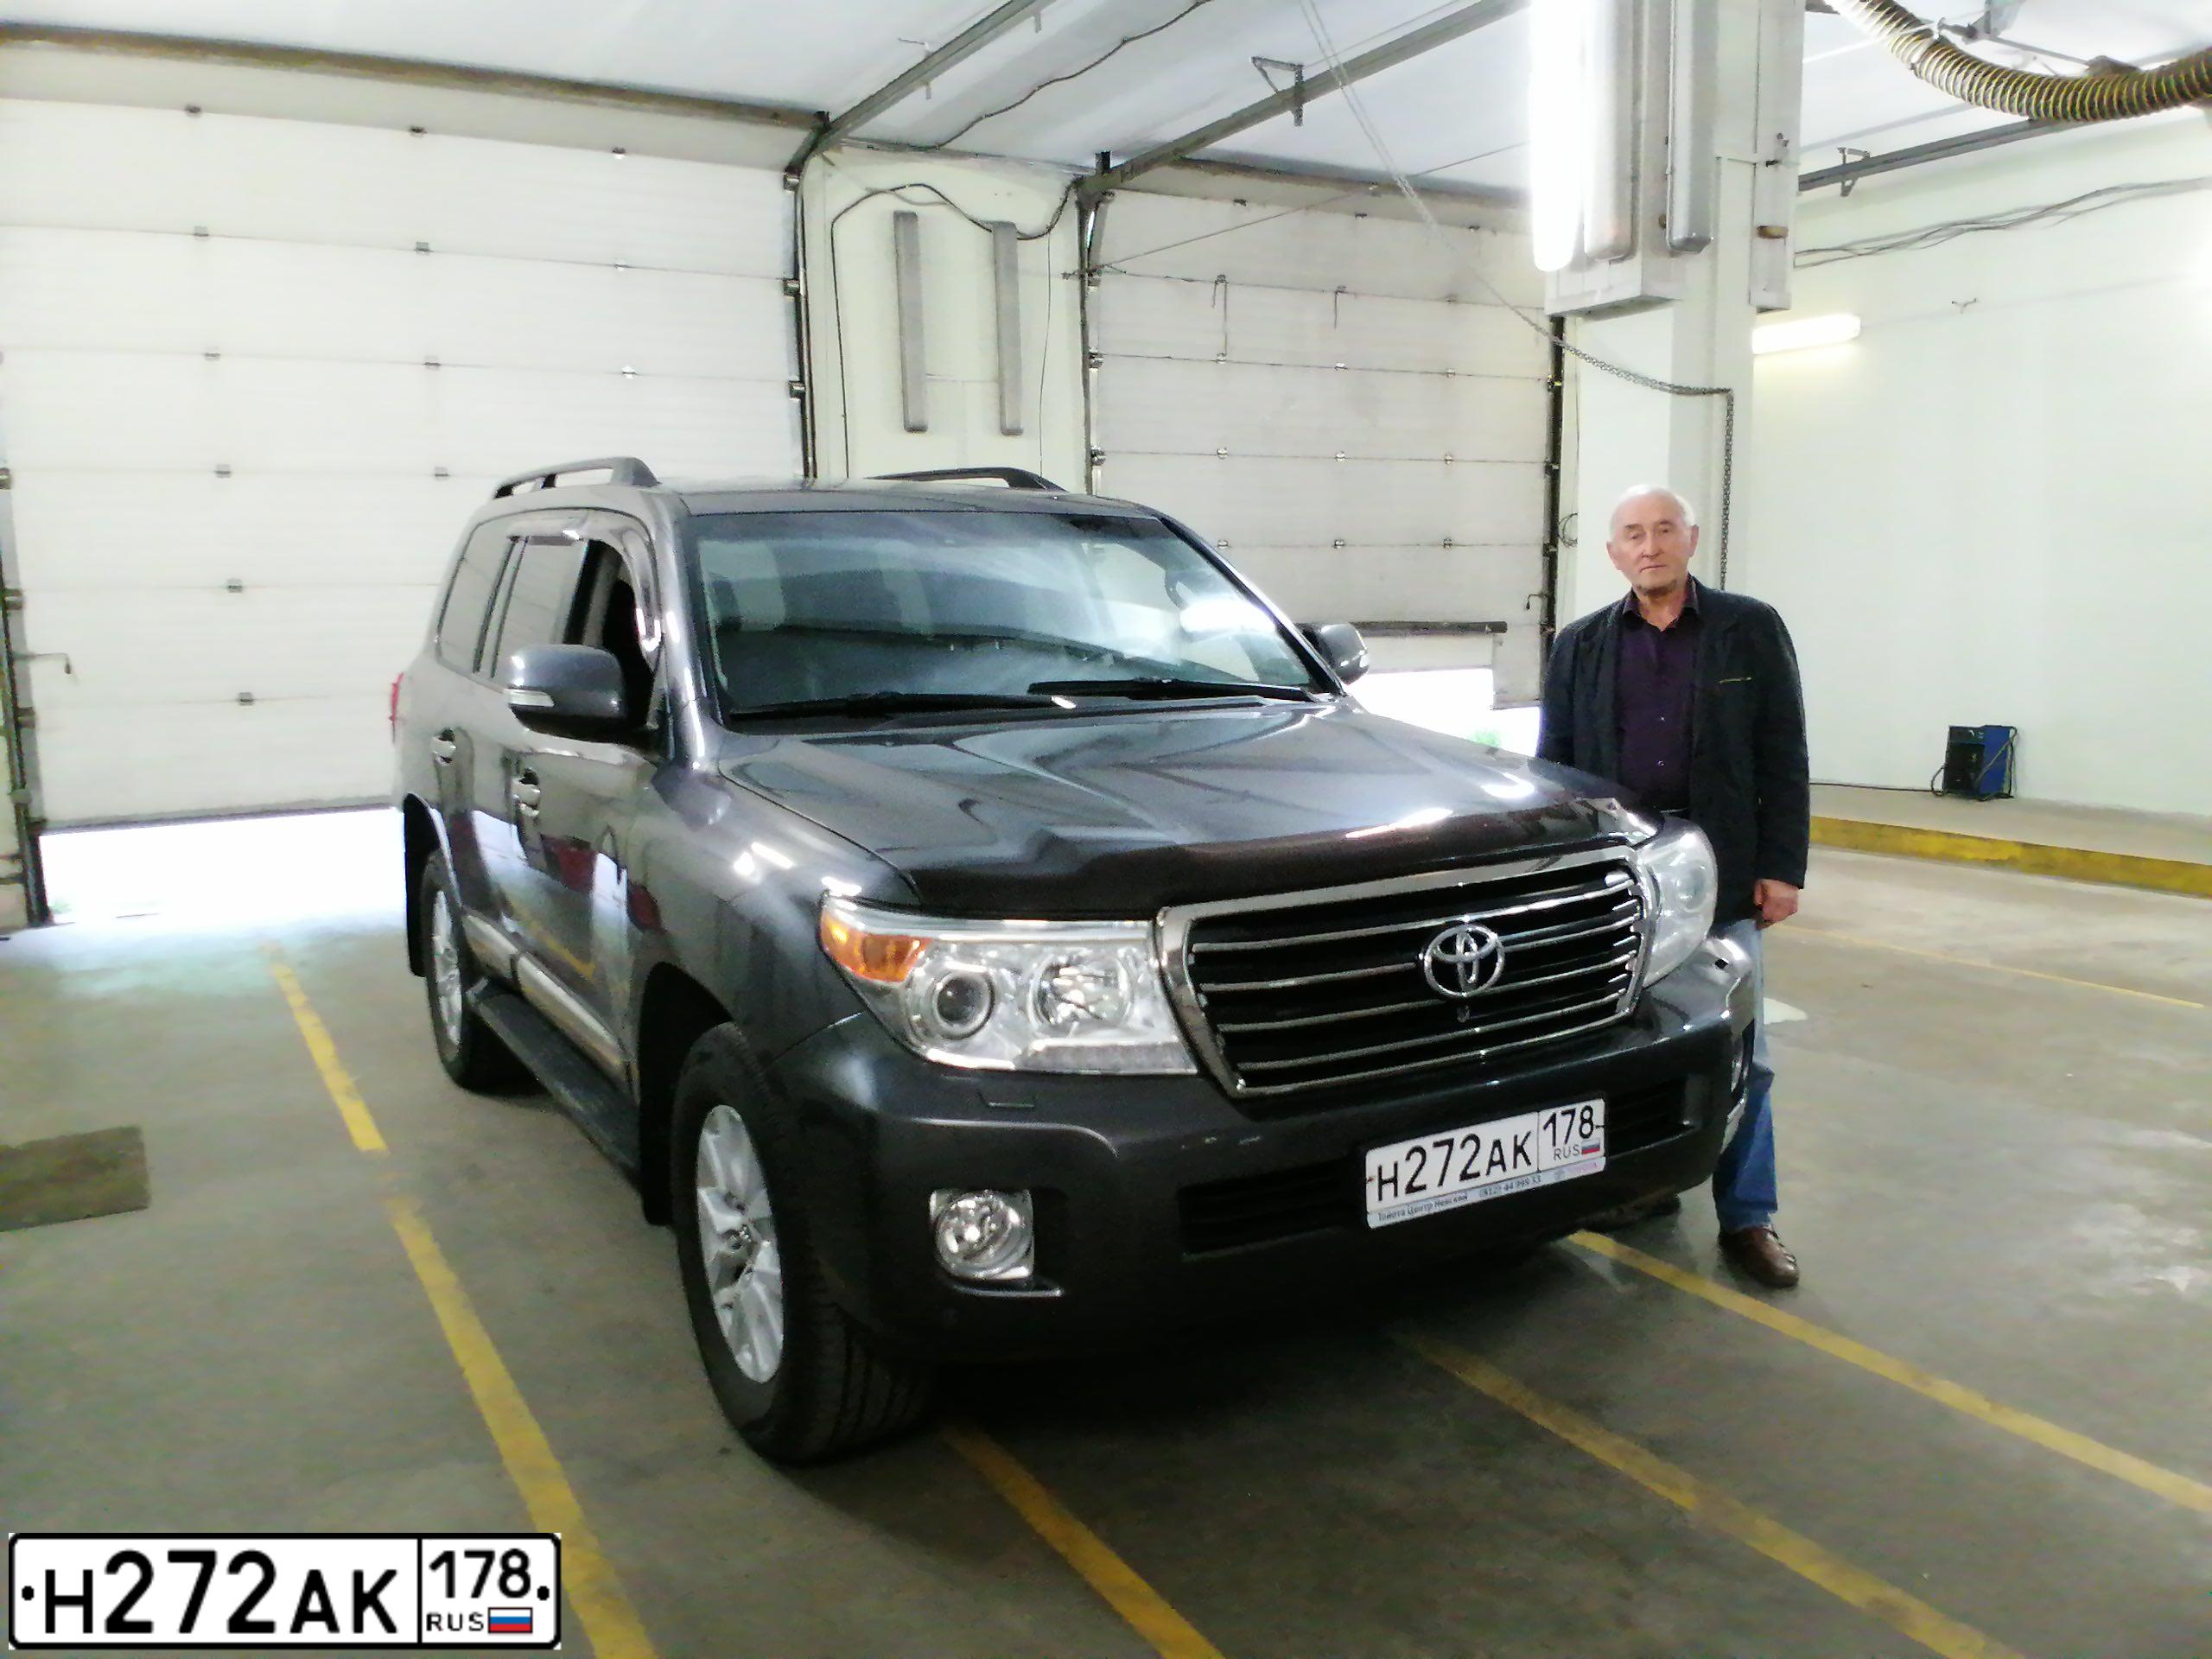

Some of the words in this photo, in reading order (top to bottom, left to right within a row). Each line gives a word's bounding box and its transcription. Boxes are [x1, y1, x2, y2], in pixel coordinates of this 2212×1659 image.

[1376, 1131, 1532, 1201] Н272АК
[1543, 1104, 1594, 1147] 178
[1554, 1144, 1580, 1161] RUS
